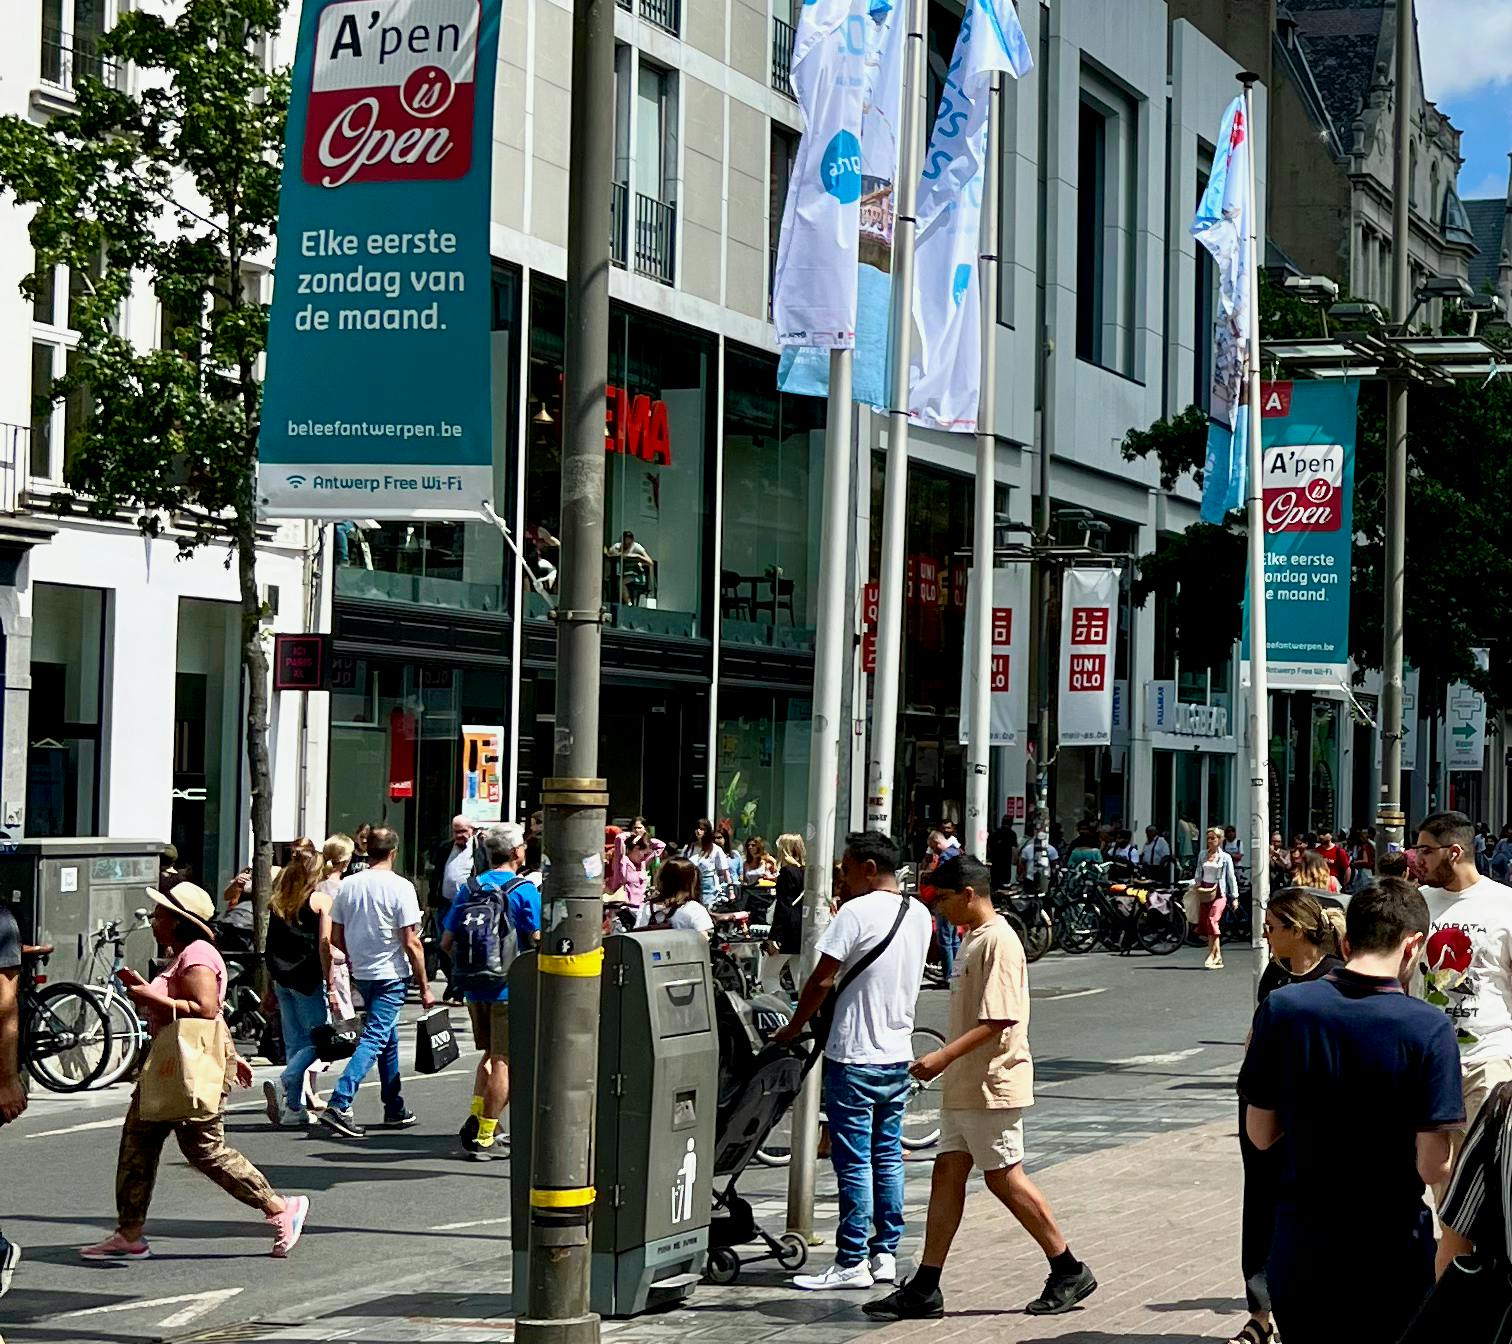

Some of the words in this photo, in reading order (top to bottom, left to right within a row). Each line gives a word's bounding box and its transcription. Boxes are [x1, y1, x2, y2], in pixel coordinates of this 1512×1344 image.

[329, 10, 460, 65] A'pen
[412, 70, 439, 109] is
[318, 96, 454, 188] Open
[301, 229, 358, 257] Elke
[366, 229, 457, 256] eerste
[297, 266, 401, 298] zondag
[411, 270, 465, 292] van
[295, 302, 329, 332] de
[338, 302, 447, 330] maand.
[1265, 392, 1282, 411] A
[287, 419, 462, 439] beleefantwerpen.be
[605, 384, 672, 468] EMA
[1270, 450, 1335, 477] A'pen
[313, 475, 380, 492] Antwerp
[384, 474, 417, 491] Free
[421, 474, 463, 491] Wi-Fi
[1312, 479, 1327, 499] is
[1265, 492, 1333, 534] Open
[1291, 553, 1335, 567] eerste
[1265, 570, 1308, 586] ondag
[1312, 572, 1338, 584] van
[1265, 590, 1274, 601] e
[1278, 588, 1329, 602] maand.
[1073, 658, 1100, 672] UNI
[1073, 674, 1101, 690] QLO
